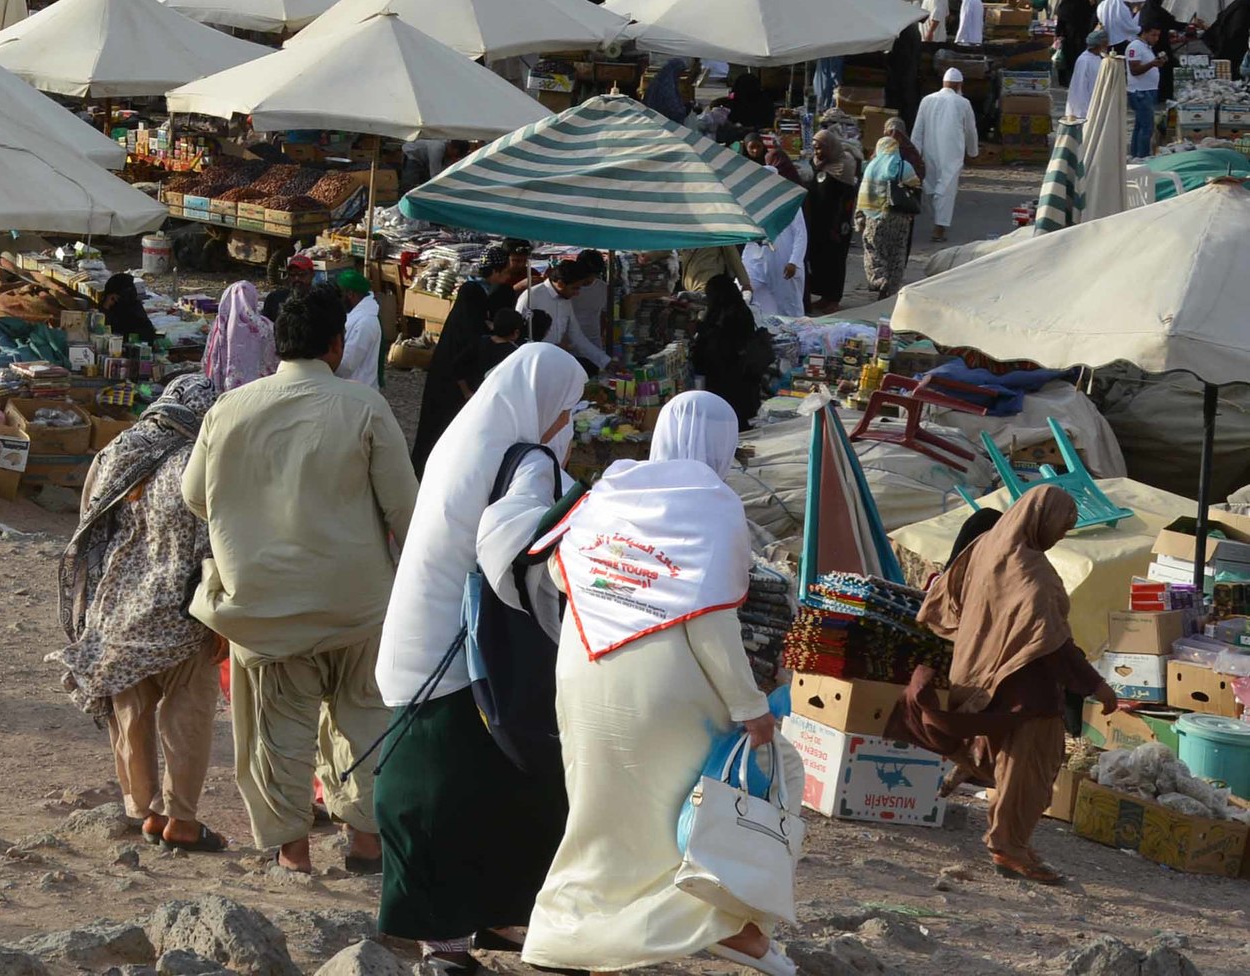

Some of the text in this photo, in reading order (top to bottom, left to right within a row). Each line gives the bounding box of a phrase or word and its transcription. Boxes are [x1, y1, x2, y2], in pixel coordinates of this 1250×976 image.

[613, 532, 656, 555] السياحة
[620, 562, 659, 581] TOURS
[1130, 686, 1150, 699] موز
